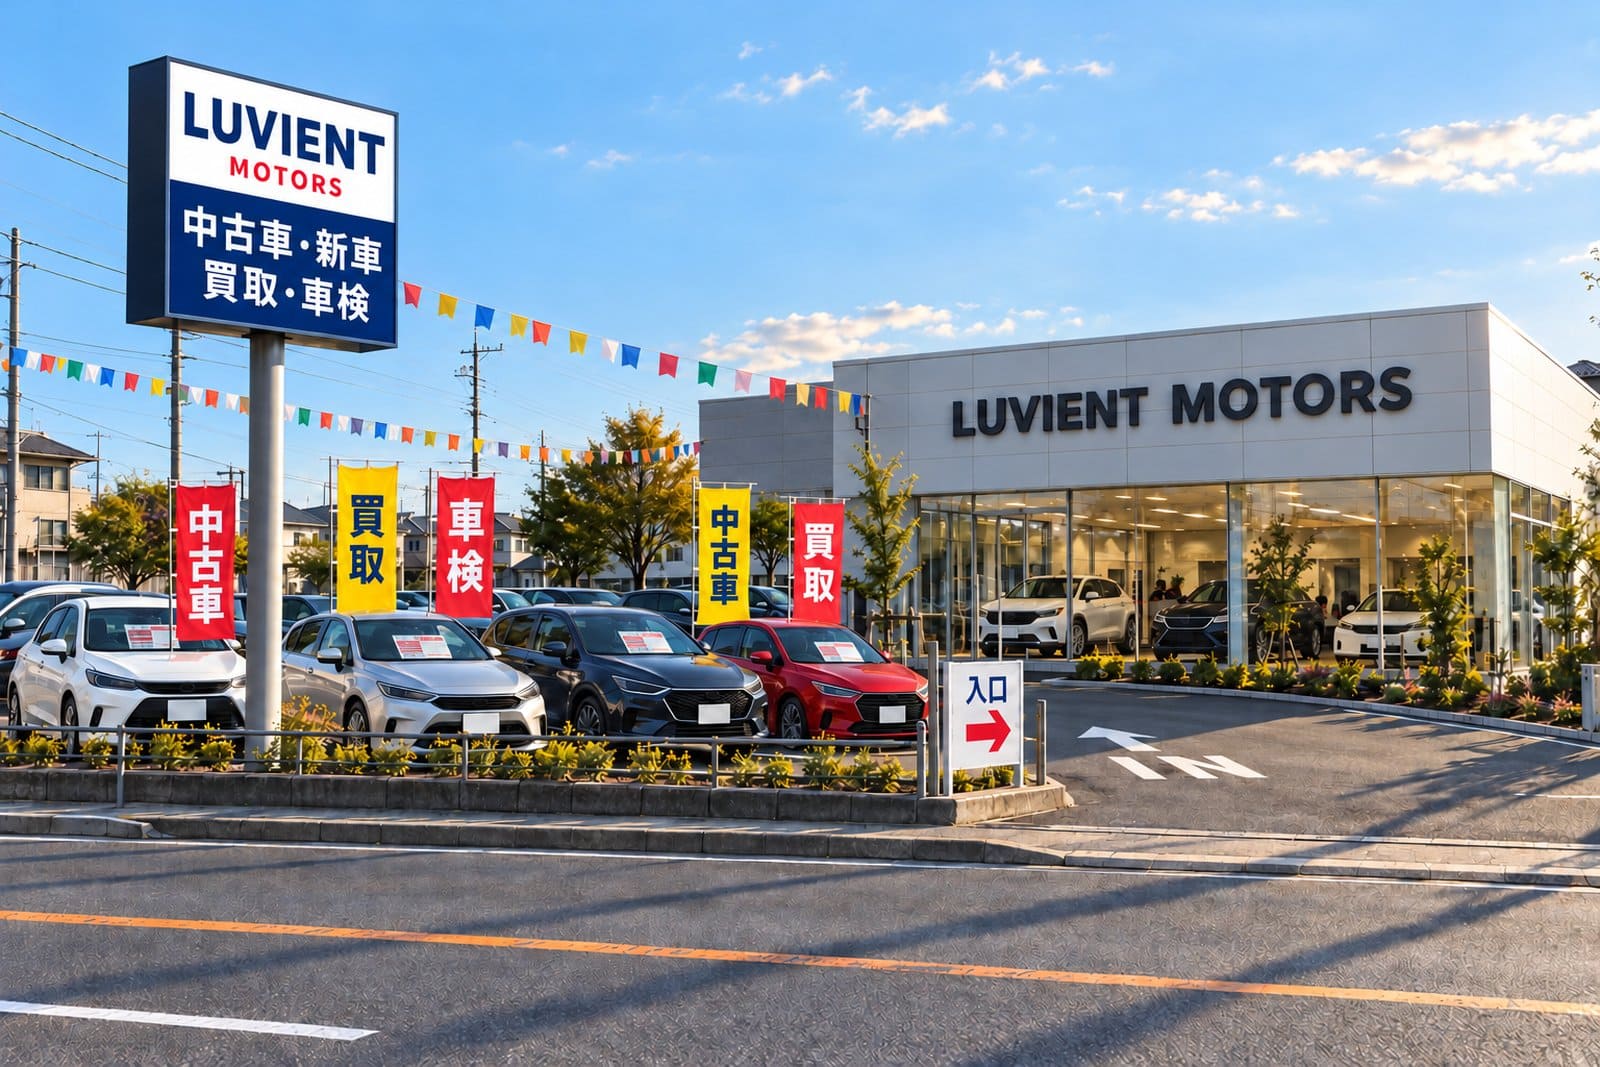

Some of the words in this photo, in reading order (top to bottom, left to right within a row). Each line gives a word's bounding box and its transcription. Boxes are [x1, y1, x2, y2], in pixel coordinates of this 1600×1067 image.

[184, 91, 385, 175] LUVIENT
[230, 156, 342, 197] MOTORS
[183, 205, 382, 275] 中古車・新車
[203, 259, 370, 323] 買取・車検
[952, 387, 1148, 437] LUVIENT
[1172, 365, 1413, 425] MOTORS
[188, 503, 225, 625] 中古車
[349, 494, 385, 585] 買取
[446, 497, 485, 594] 車検
[710, 503, 739, 606] 中古車
[803, 522, 835, 603] 買取
[966, 675, 1007, 705] 入口
[1108, 755, 1268, 780] IN
